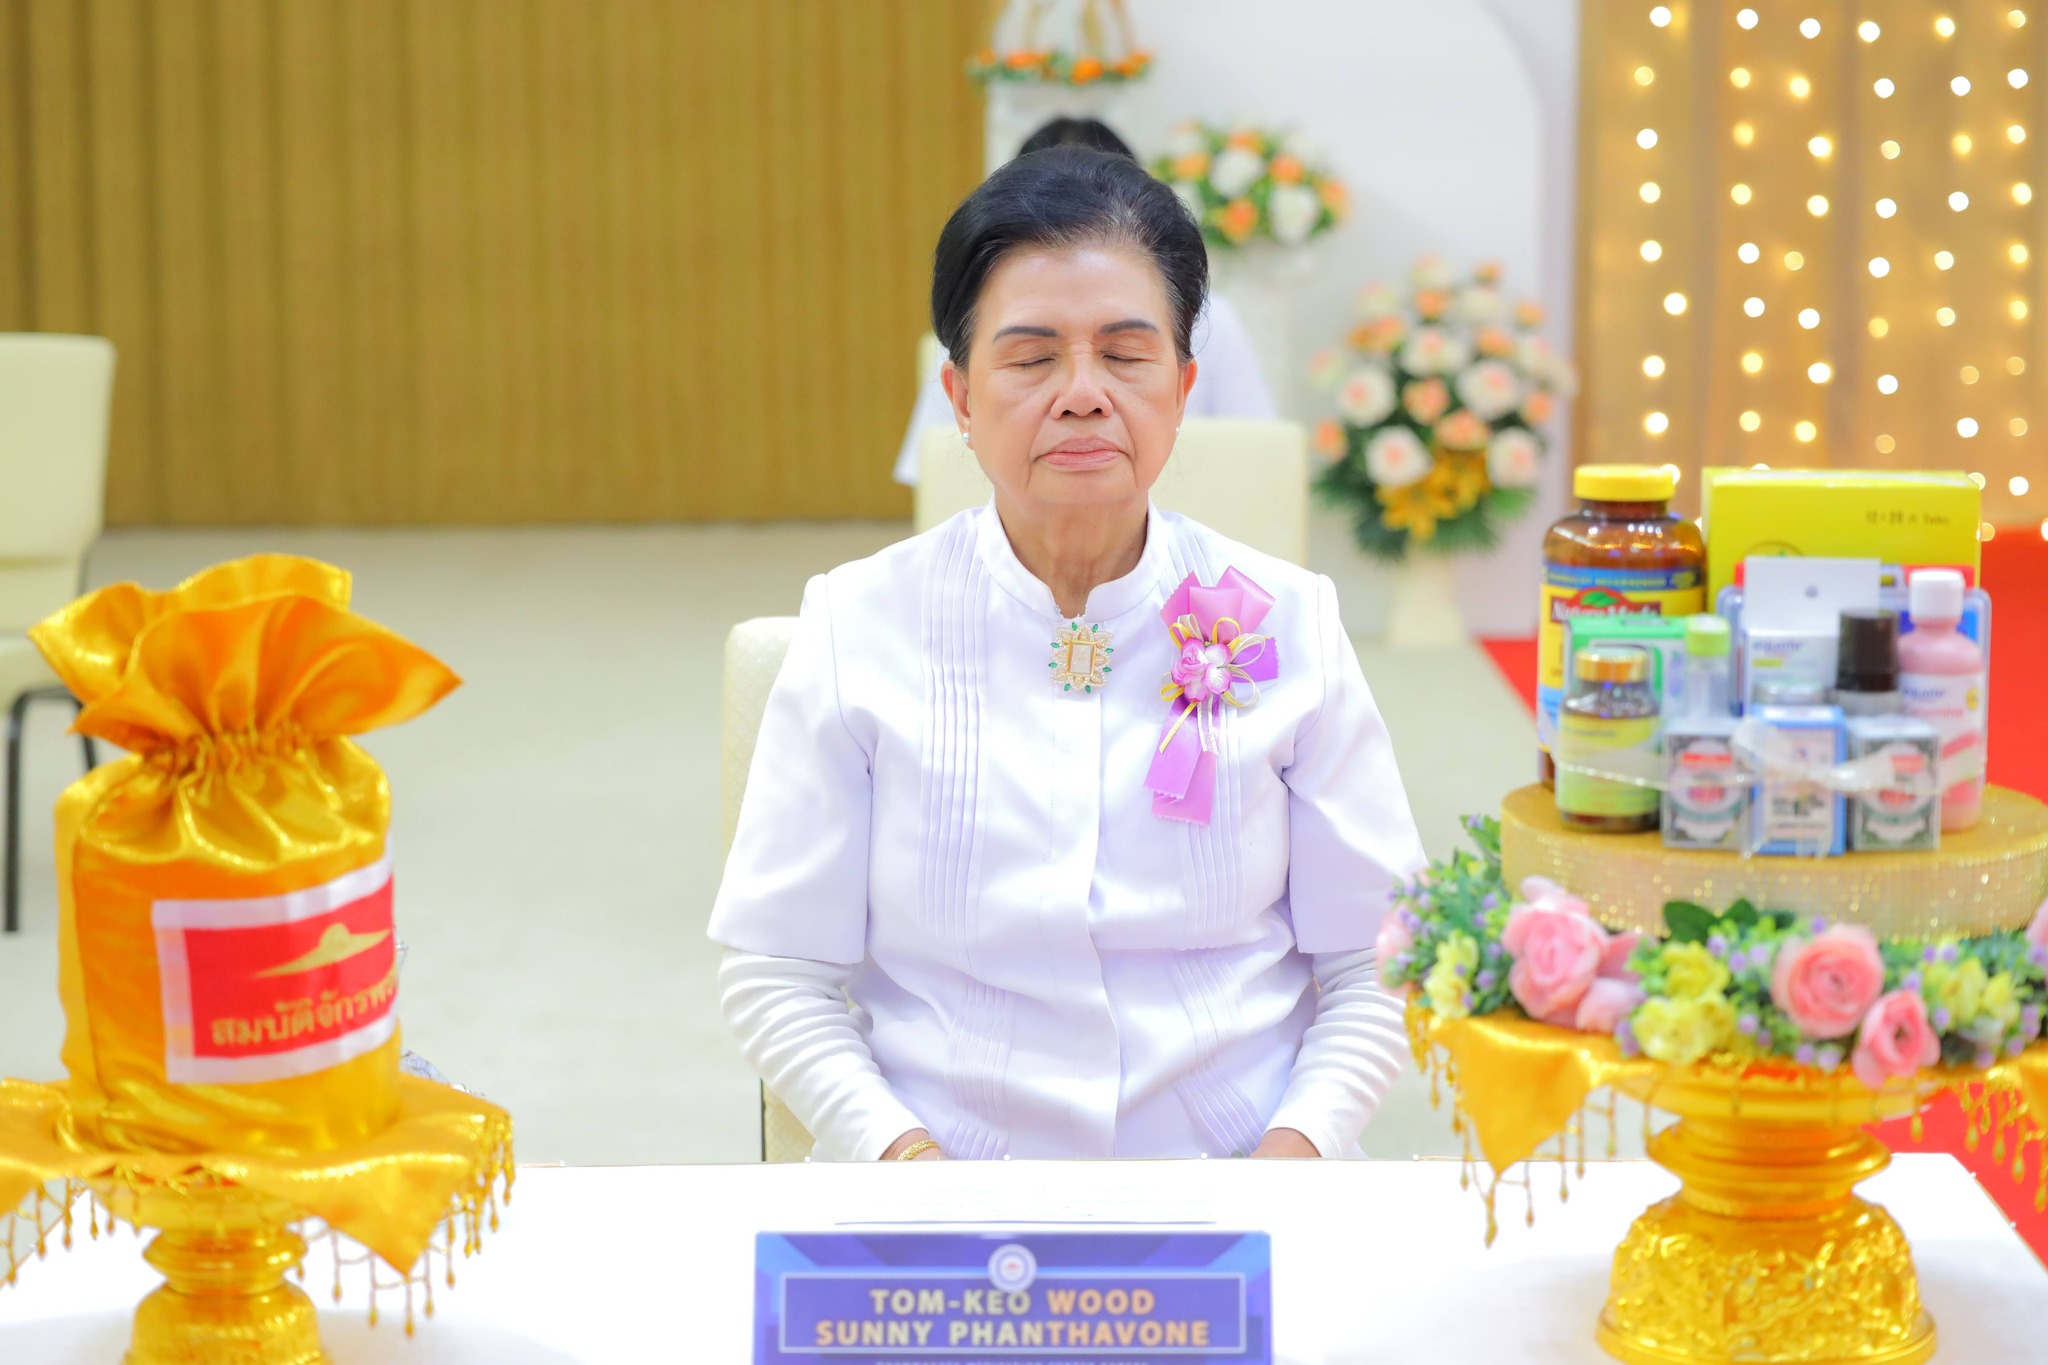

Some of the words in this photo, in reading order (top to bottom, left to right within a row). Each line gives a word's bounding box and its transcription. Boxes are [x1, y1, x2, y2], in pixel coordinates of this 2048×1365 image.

[870, 1289, 1032, 1315] TOM-KEO
[1046, 1289, 1156, 1316] WOOD
[815, 1320, 934, 1348] SUNNY
[948, 1321, 1211, 1348] PHANTHAVONE
